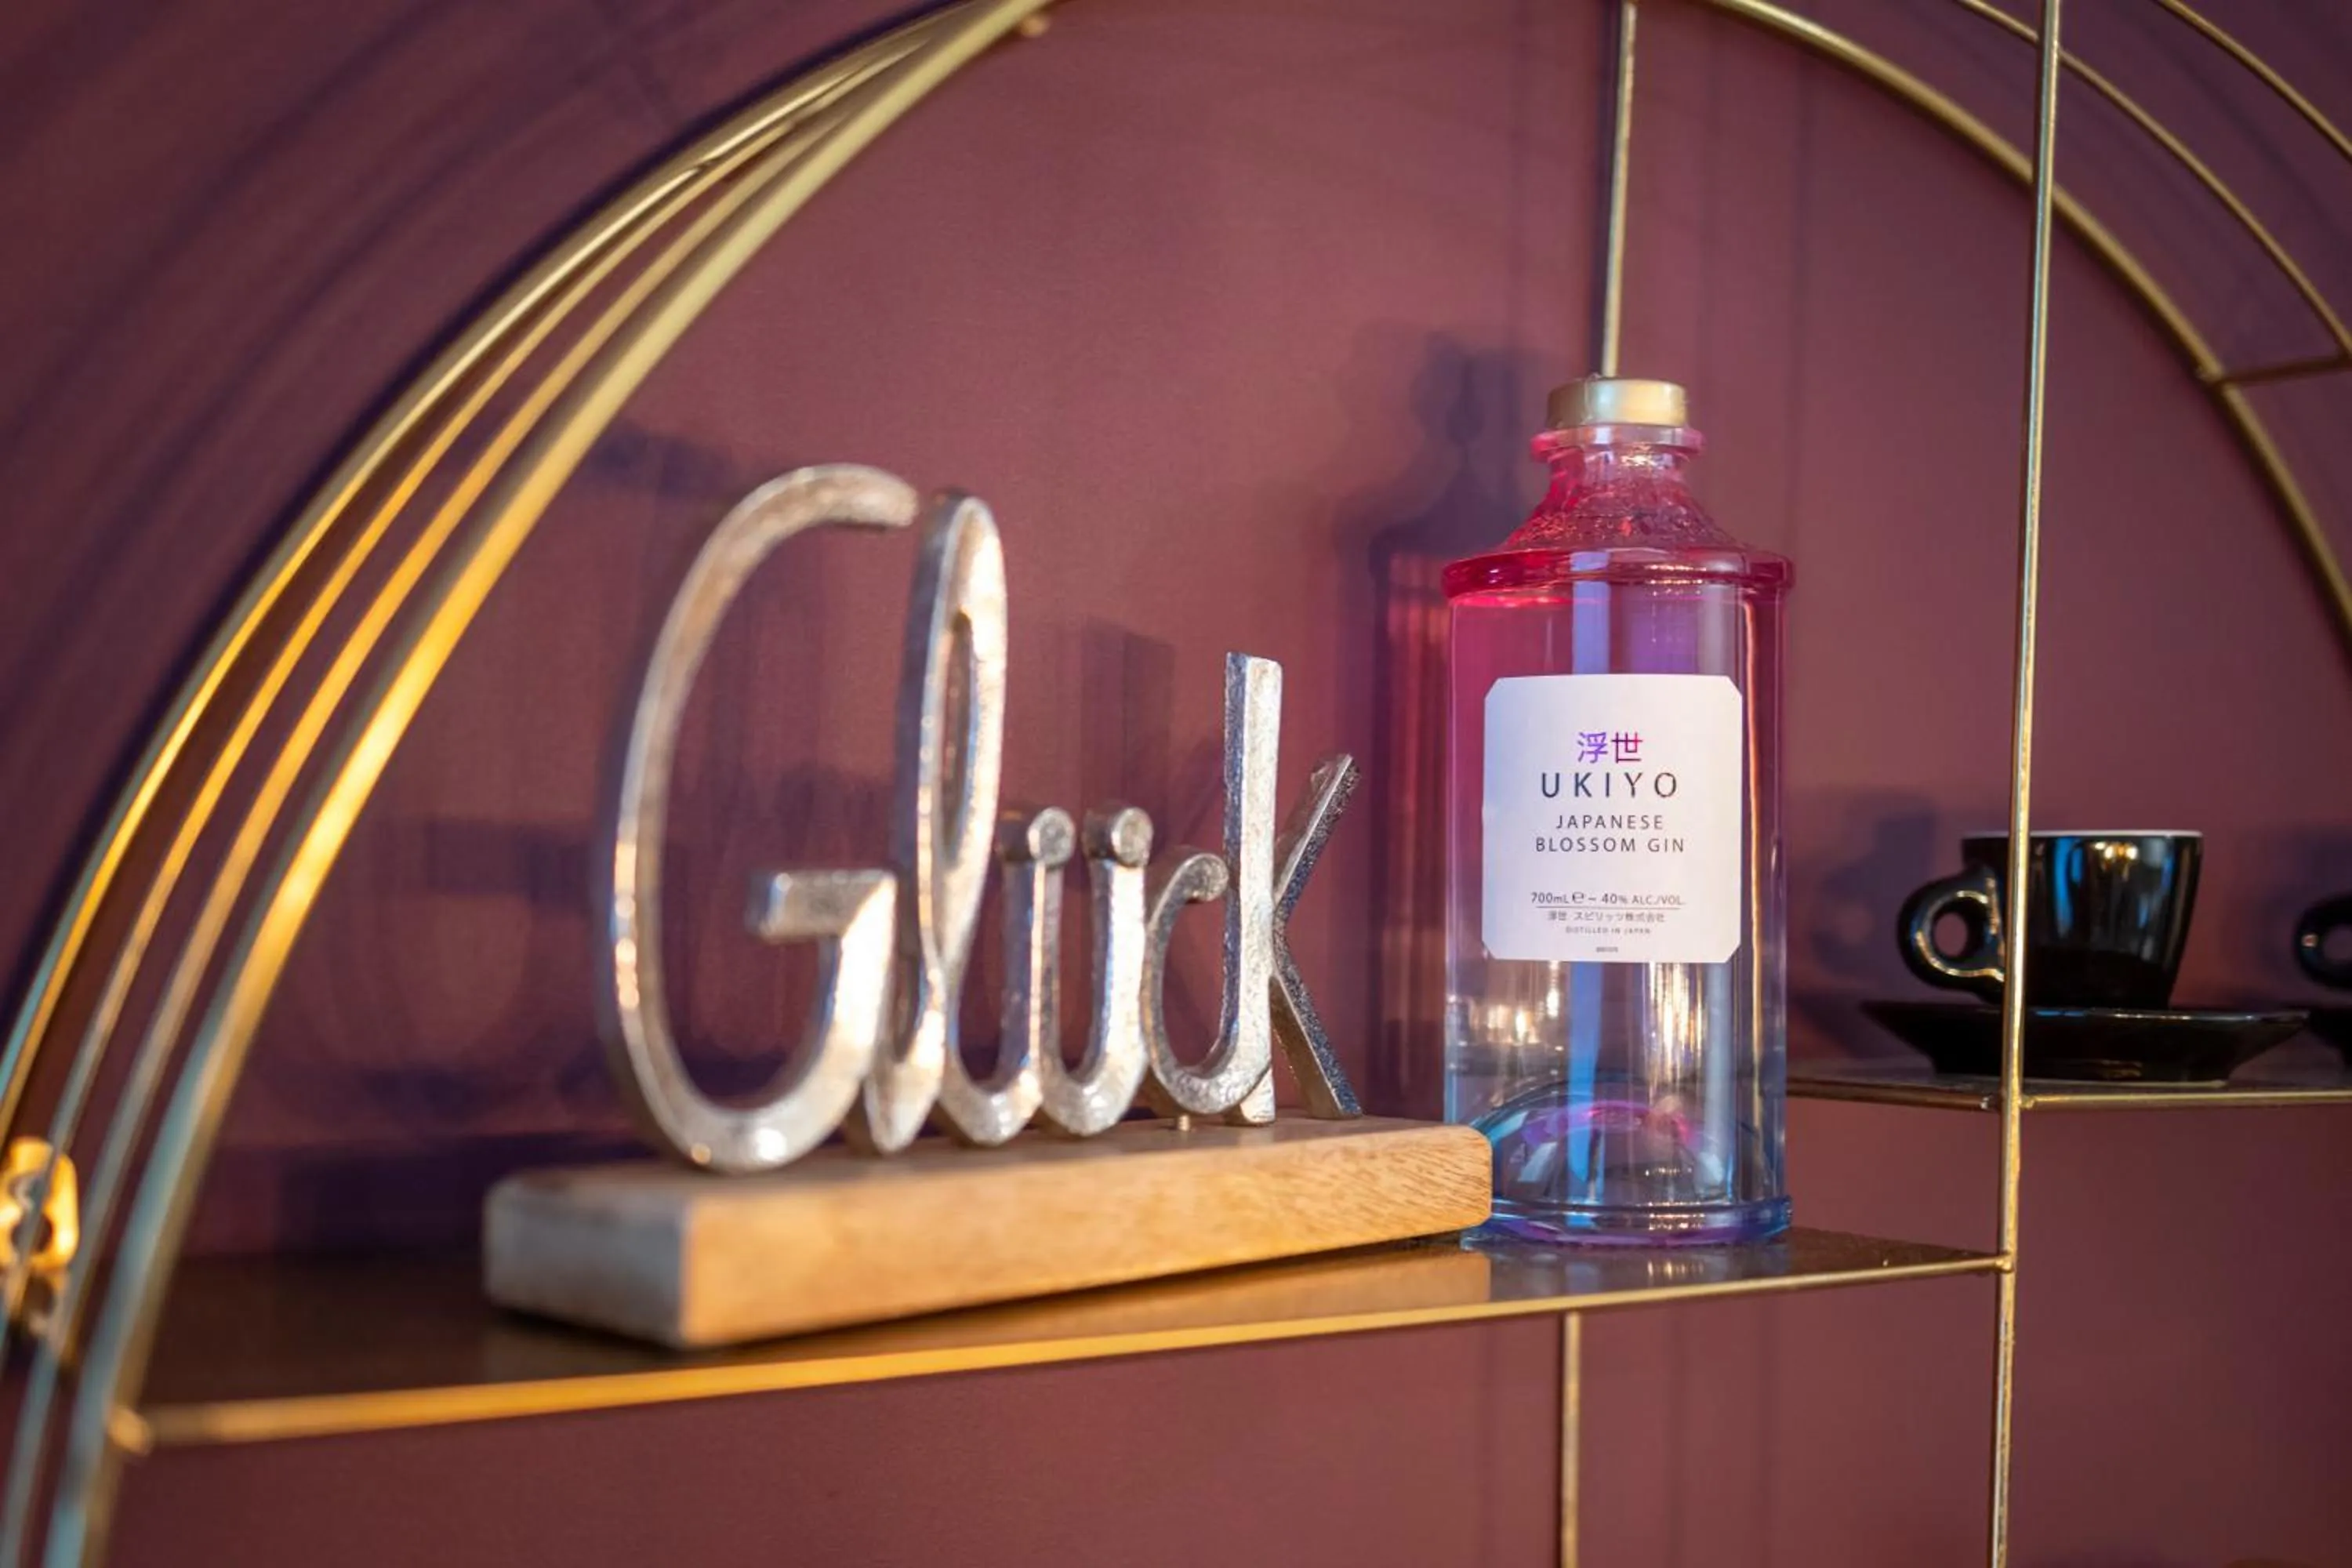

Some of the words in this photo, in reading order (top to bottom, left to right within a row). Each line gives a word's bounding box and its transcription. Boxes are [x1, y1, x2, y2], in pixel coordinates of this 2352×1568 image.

[1576, 731, 1643, 764] 浮世
[1541, 771, 1678, 799] UKIYO
[1555, 814, 1664, 830] JAPANESE
[1534, 836, 1637, 853] BLOSSOM
[1646, 837, 1686, 854] GIN
[1601, 892, 1628, 905] 40%
